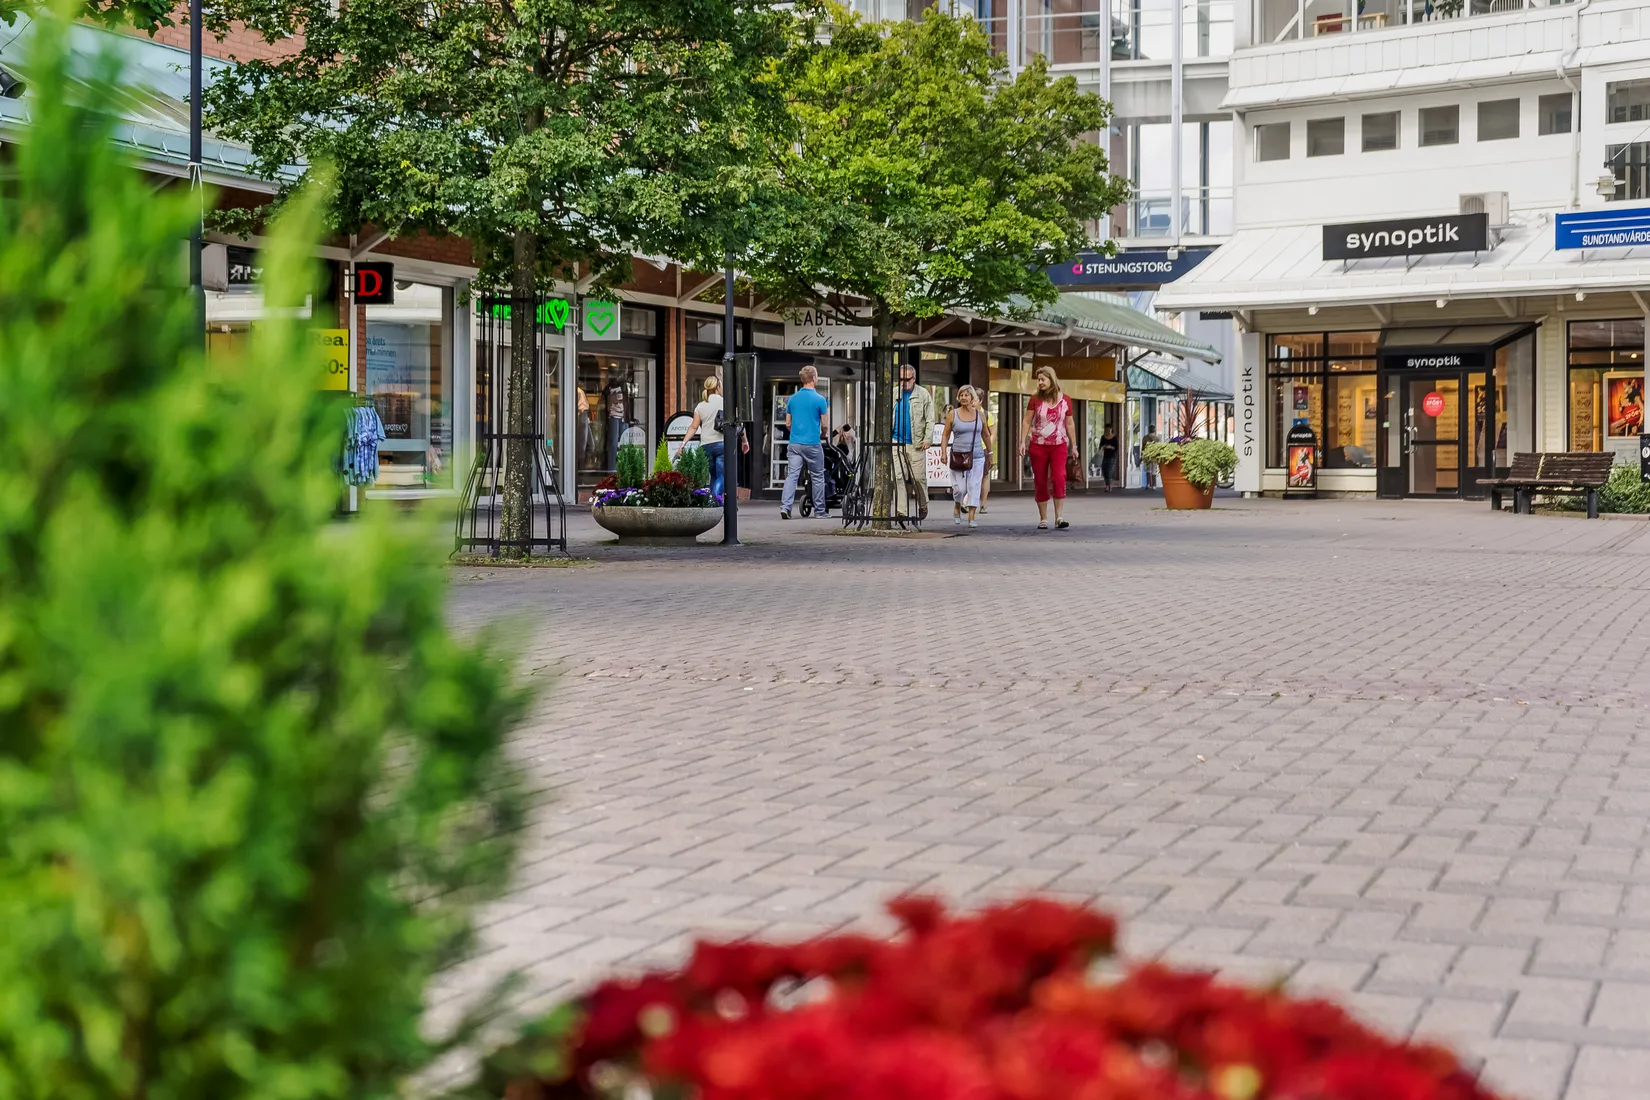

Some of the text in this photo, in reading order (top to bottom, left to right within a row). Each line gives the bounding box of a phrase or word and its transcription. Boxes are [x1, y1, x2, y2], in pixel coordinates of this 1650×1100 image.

[1346, 223, 1460, 252] synoptik
[1086, 261, 1173, 274] STENUNGSTORG
[794, 309, 862, 327] LABEL
[815, 327, 826, 338] &
[795, 335, 860, 347] Karlsson
[1407, 355, 1461, 369] synoptik
[1241, 366, 1255, 457] synoptik
[928, 470, 949, 479] 70%
